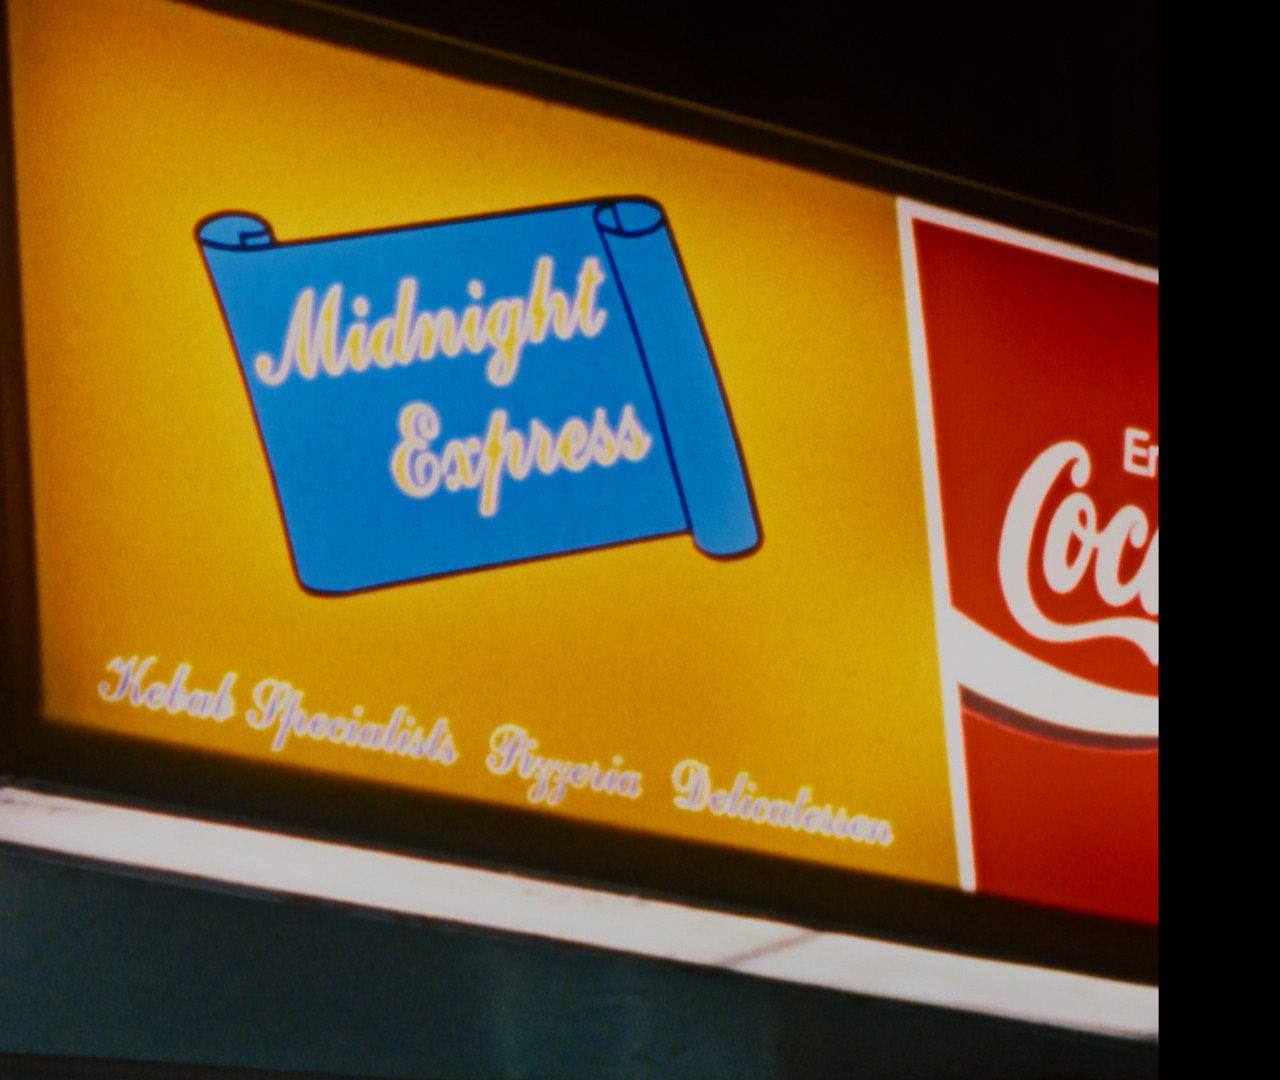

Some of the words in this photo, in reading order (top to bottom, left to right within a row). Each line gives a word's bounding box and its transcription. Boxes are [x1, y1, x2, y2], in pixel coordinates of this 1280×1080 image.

[253, 254, 607, 386] Midnight
[390, 401, 652, 517] Express
[998, 440, 1159, 664] Coc
[99, 655, 237, 721] Kebab
[245, 679, 458, 766] Specialists
[486, 725, 642, 804] Pizzeria
